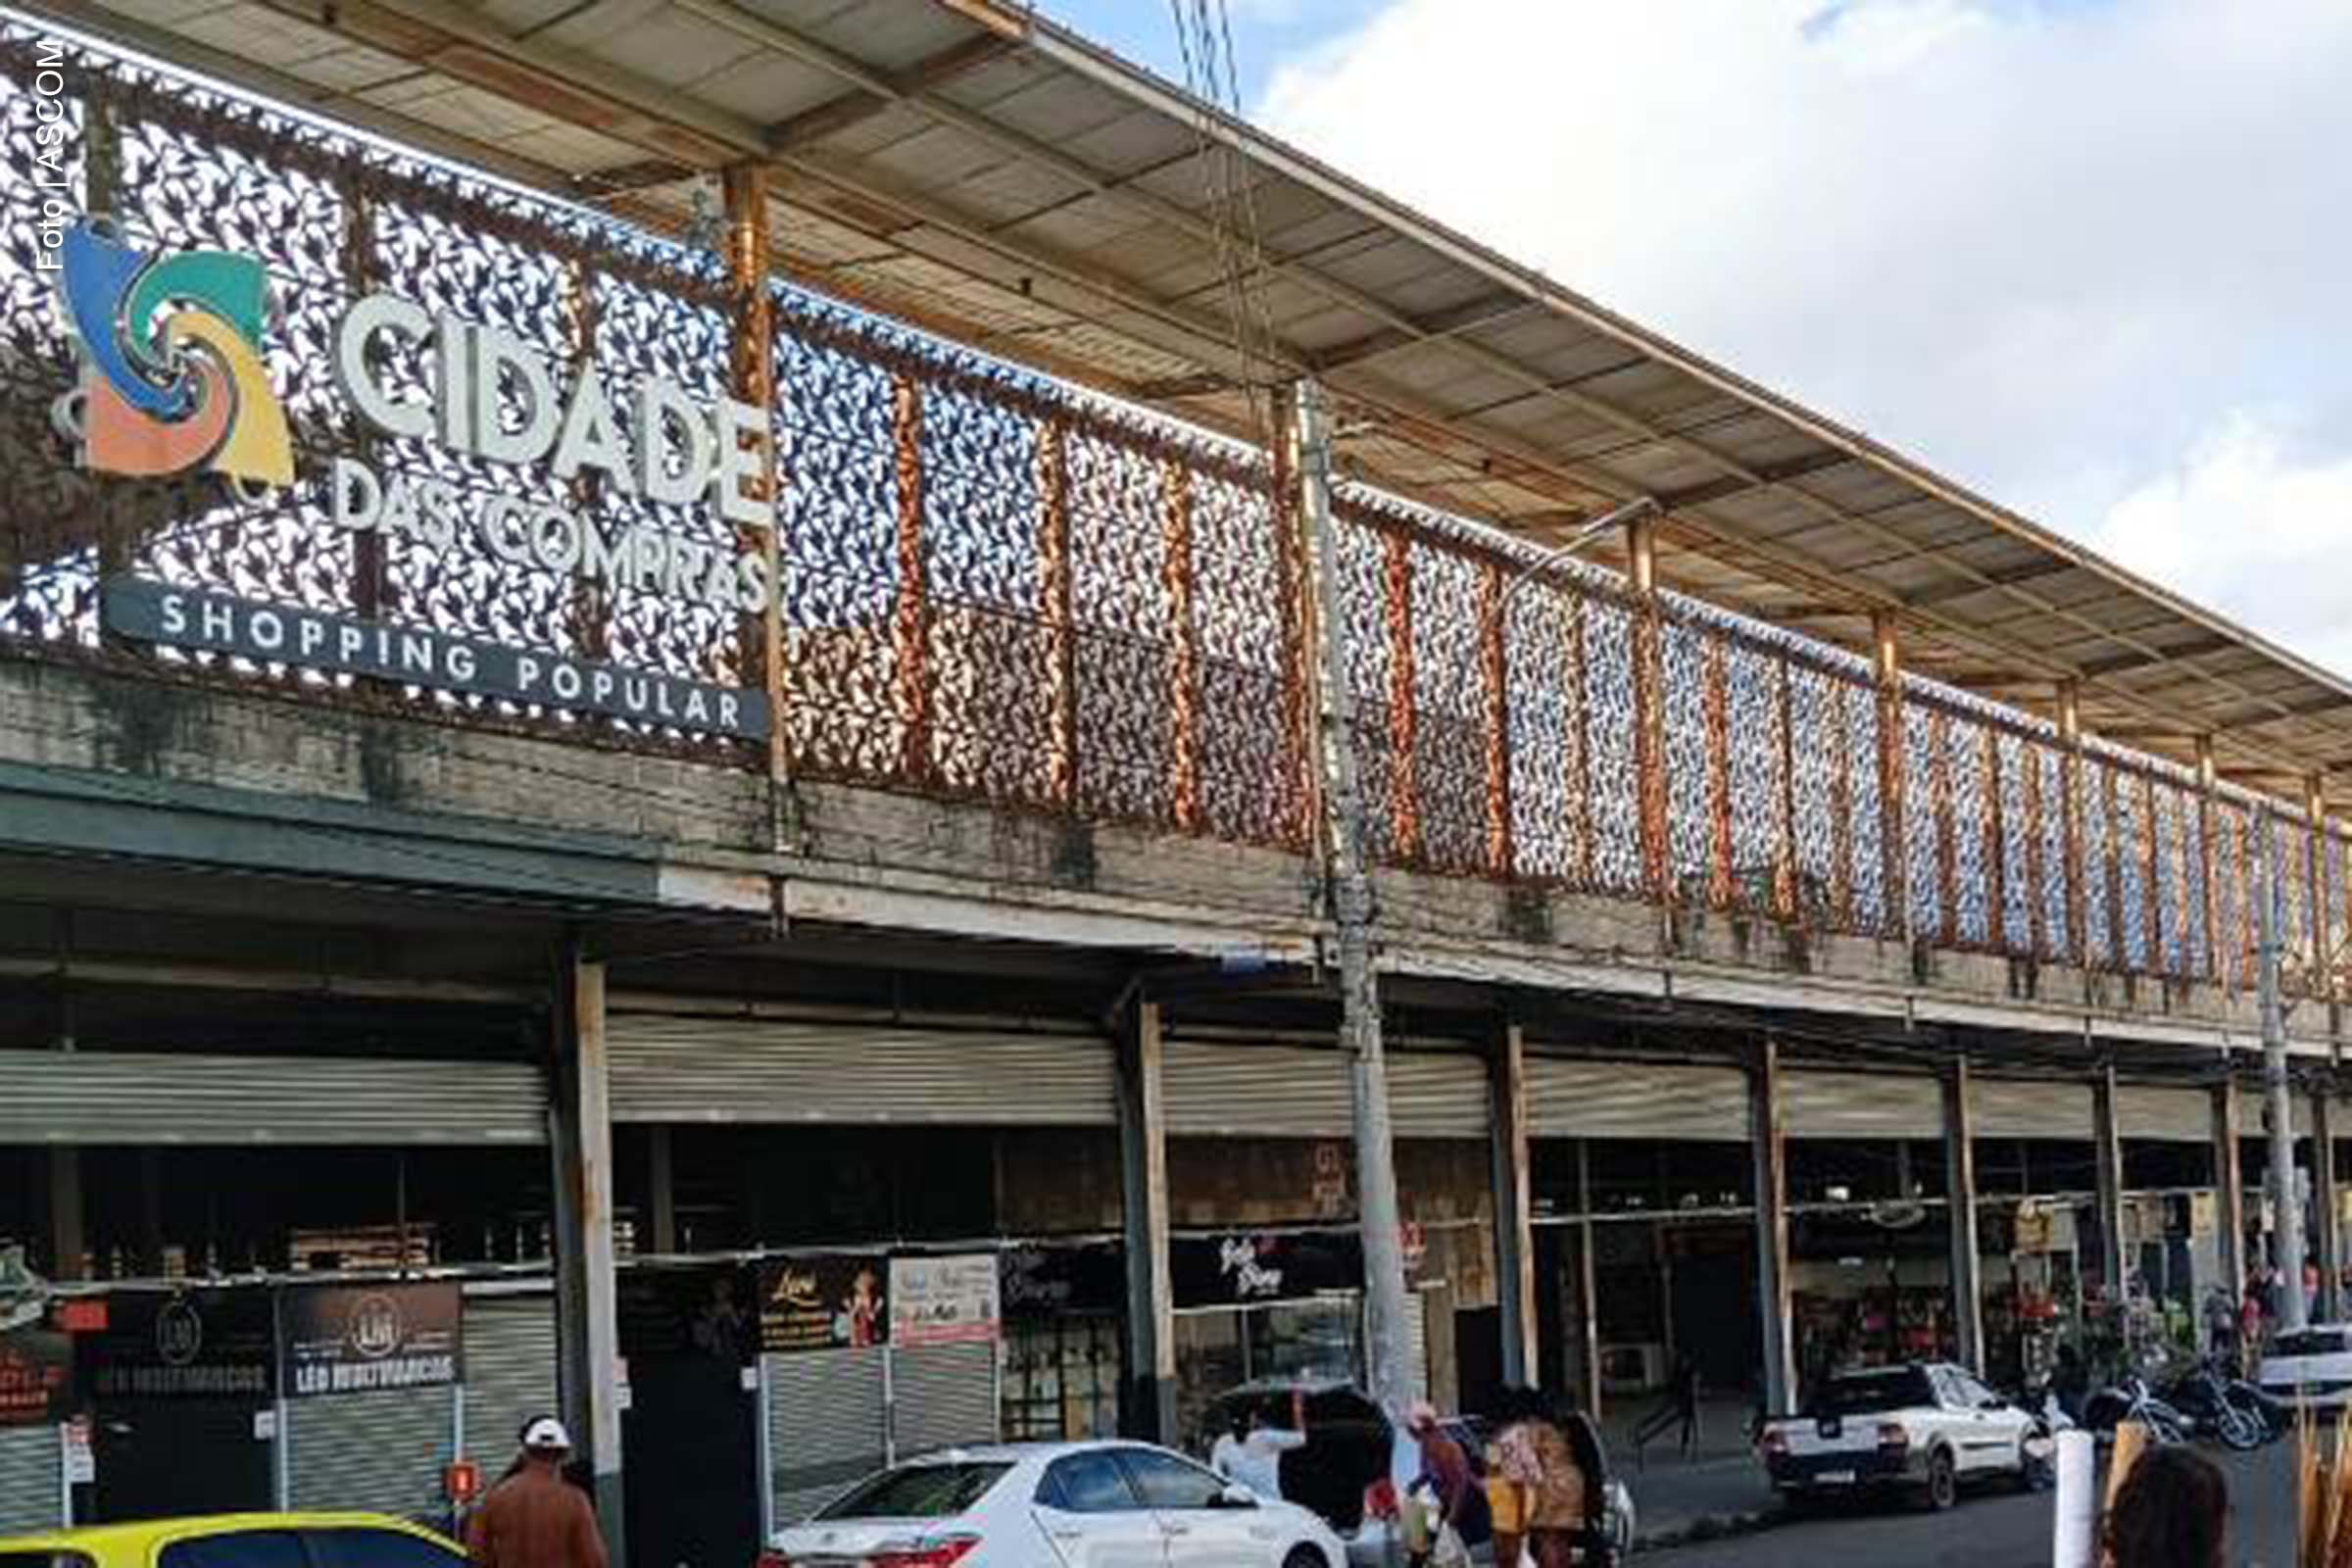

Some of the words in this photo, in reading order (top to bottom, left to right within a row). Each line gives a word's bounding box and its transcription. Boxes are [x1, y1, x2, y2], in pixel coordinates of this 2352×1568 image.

[339, 293, 772, 526] CIDADE
[334, 458, 455, 550] DAS
[483, 495, 769, 613] COMPRAS
[160, 594, 477, 683] SHOPPING
[517, 658, 740, 728] POPULAR
